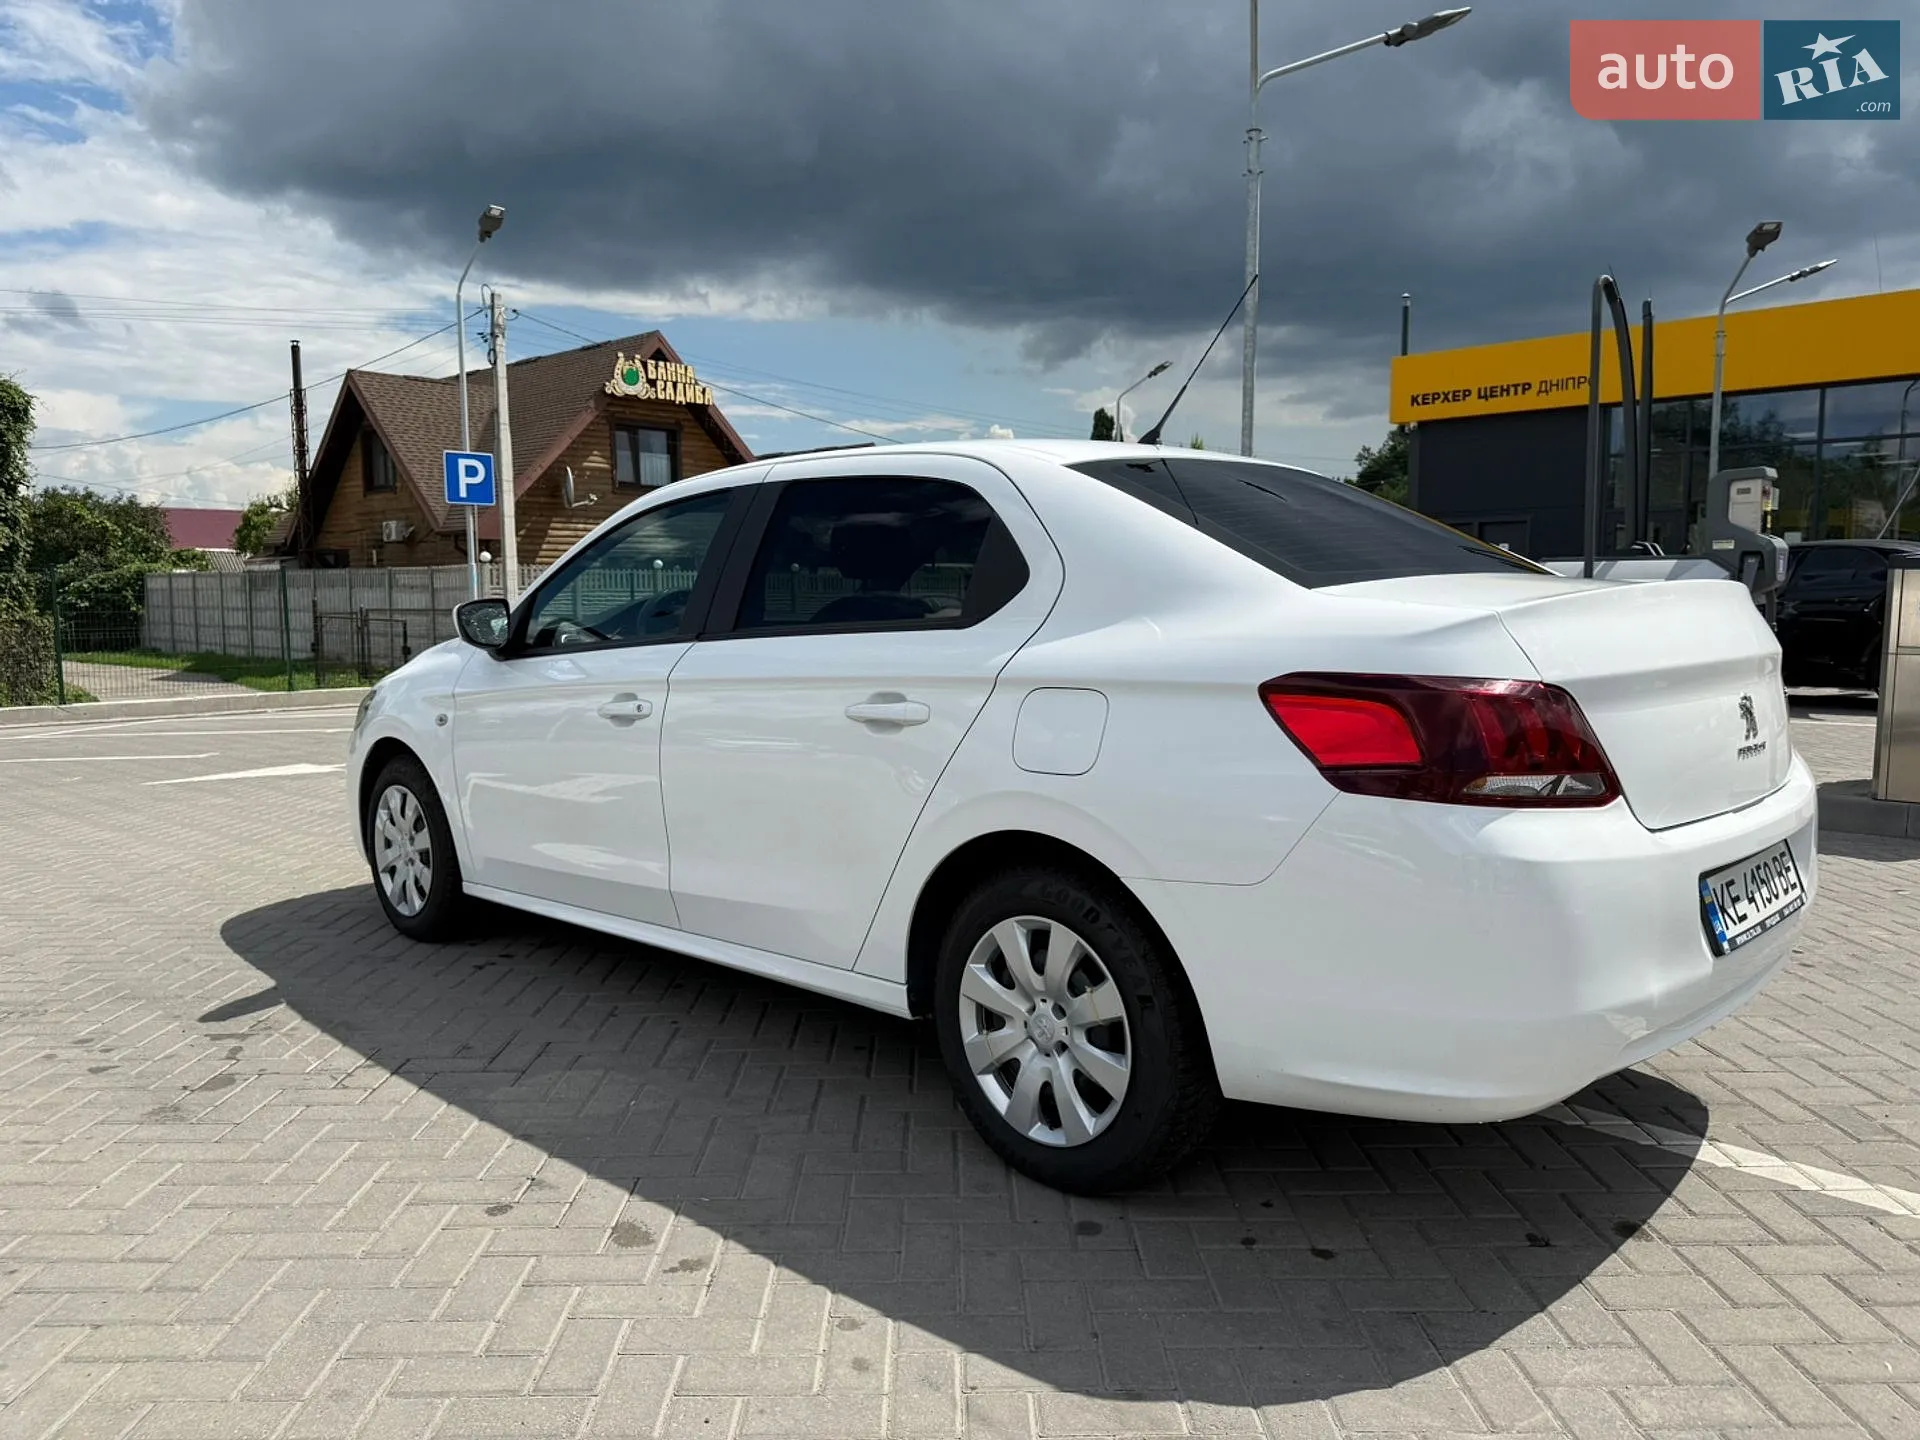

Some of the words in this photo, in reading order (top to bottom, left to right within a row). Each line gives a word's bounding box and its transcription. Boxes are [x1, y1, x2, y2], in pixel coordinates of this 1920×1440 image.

[648, 359, 695, 384] БАННА
[657, 380, 712, 405] САДИБА
[1410, 388, 1472, 407] КЕРХЕР
[1477, 382, 1532, 401] ЦЕНТР
[458, 458, 486, 498] P
[1713, 879, 1747, 930] KE
[1744, 862, 1779, 912] 4150
[1773, 852, 1797, 895] BE
